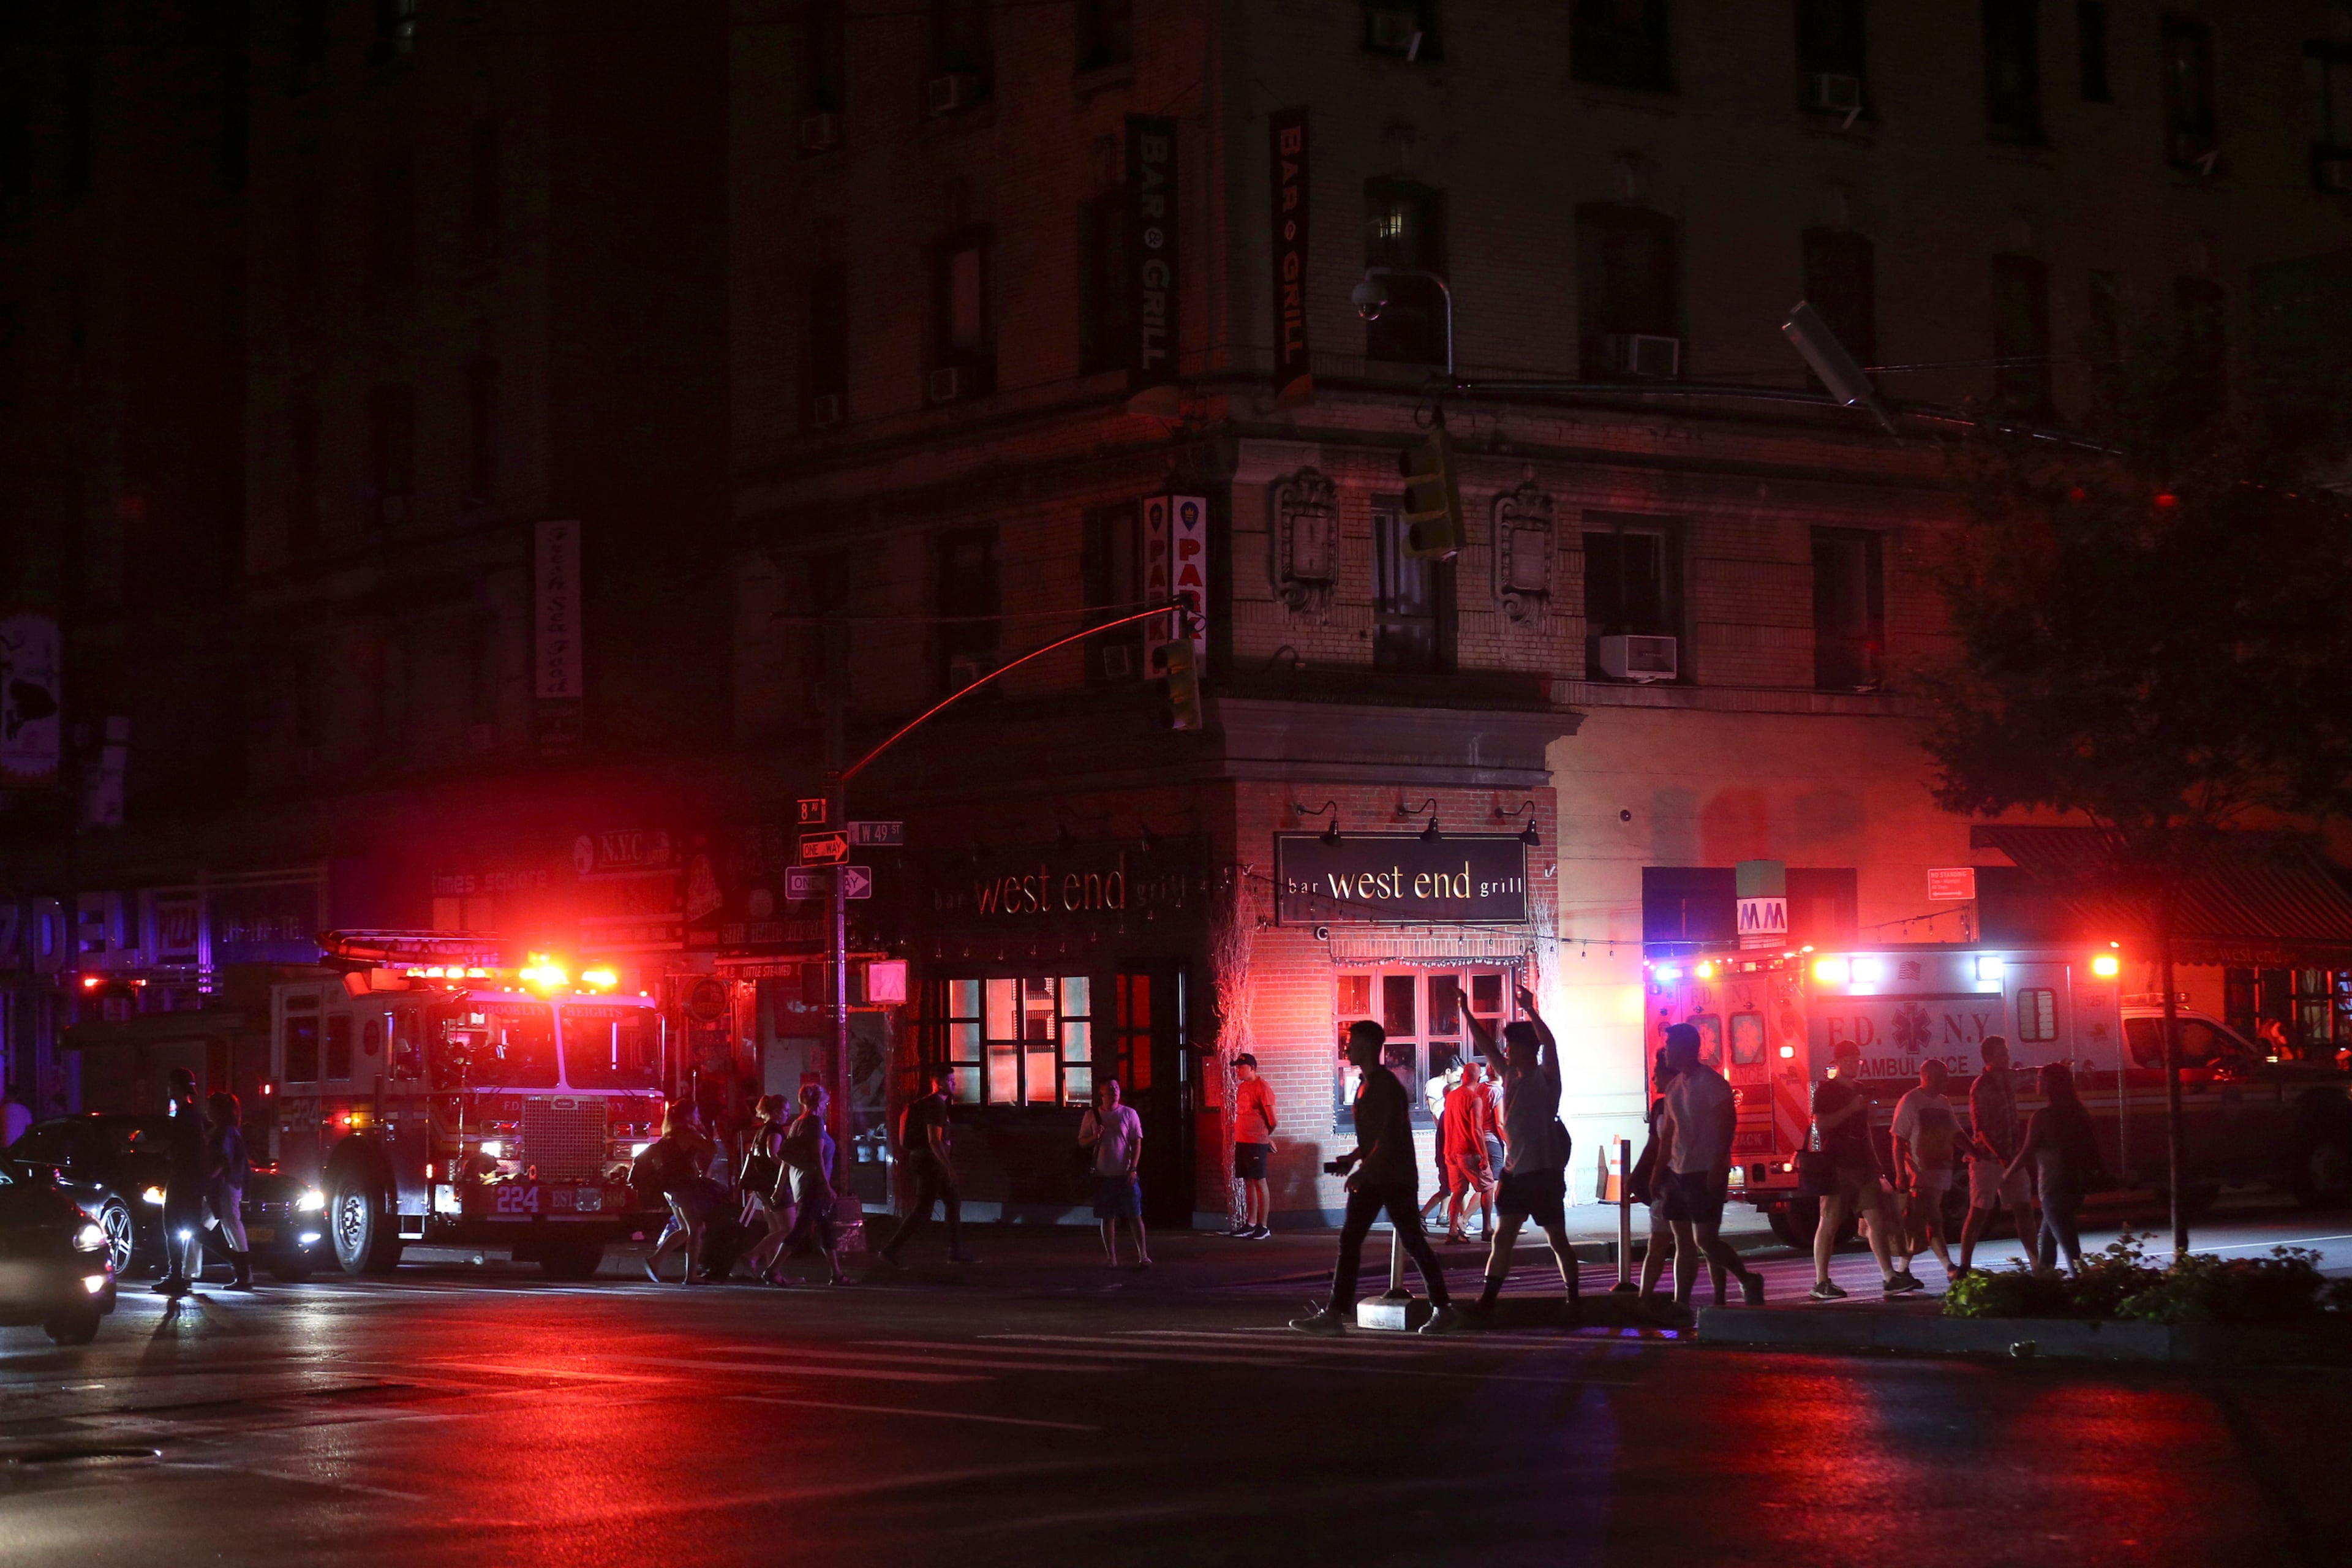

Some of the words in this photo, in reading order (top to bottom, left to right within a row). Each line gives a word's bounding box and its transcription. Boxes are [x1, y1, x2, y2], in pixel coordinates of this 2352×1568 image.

[1140, 134, 1169, 219] BAR
[1280, 126, 1302, 213] BAR
[1142, 258, 1170, 369] GRILL
[1283, 250, 1303, 364] GRILL
[548, 596, 567, 632] Sea
[801, 802, 809, 820] 8
[811, 802, 820, 812] AV
[861, 825, 872, 842] W
[874, 824, 888, 842] 49
[891, 824, 900, 834] ST
[804, 843, 819, 856] ONE
[827, 842, 842, 854] WAY
[794, 877, 819, 889] ONE
[844, 877, 859, 888] AY
[978, 863, 1052, 915] west
[1063, 852, 1126, 911] end
[1288, 878, 1319, 894] bar
[1328, 865, 1404, 900] west
[1414, 861, 1471, 899] end
[1479, 878, 1522, 897] grill
[33, 888, 157, 973] DELI
[742, 965, 761, 978] LITTLE
[763, 965, 792, 977] STEAMED
[478, 1004, 546, 1016] BROOKLYN
[566, 1007, 624, 1018] HEIGHTS
[1860, 1056, 1968, 1077] AMBULCE
[292, 1099, 319, 1132] 224
[607, 1103, 624, 1112] N.Y.
[497, 1186, 539, 1213] 224
[601, 1191, 626, 1207] 1886
